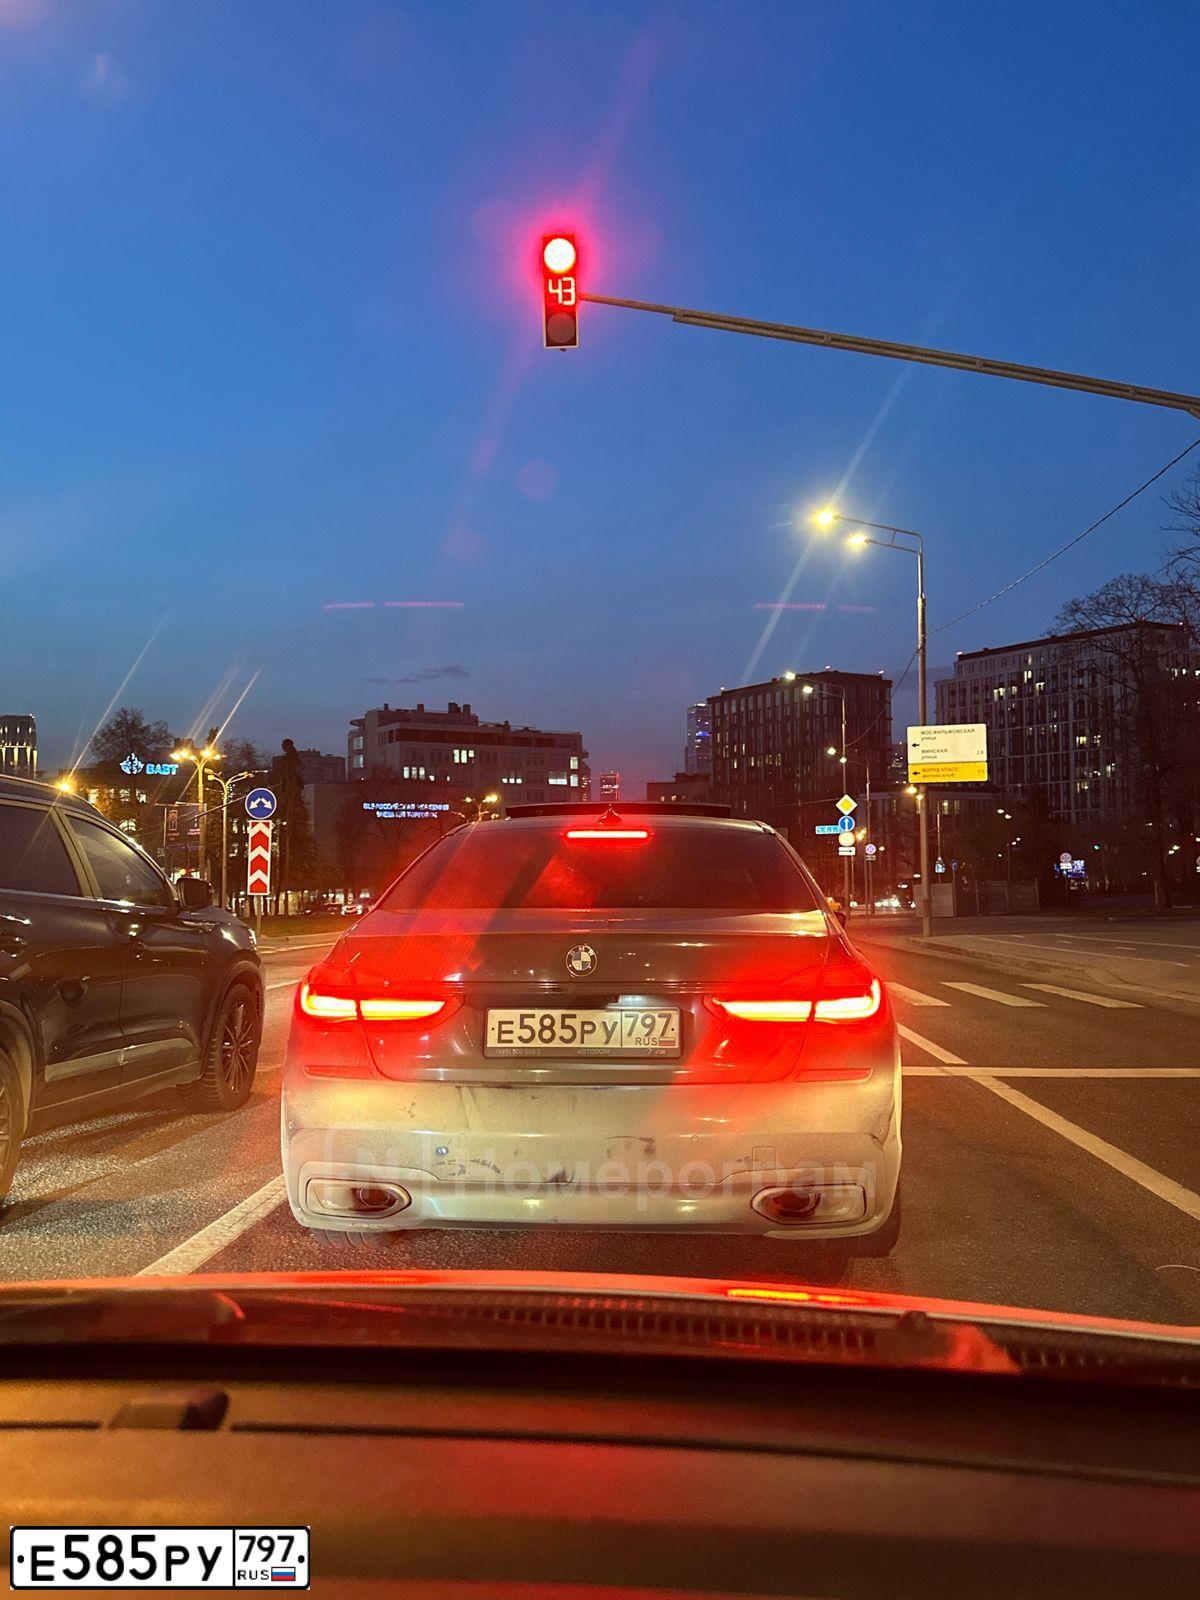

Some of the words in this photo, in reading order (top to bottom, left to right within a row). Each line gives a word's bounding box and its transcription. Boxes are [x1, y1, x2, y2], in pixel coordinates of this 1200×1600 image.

[548, 277, 575, 305] 43
[624, 1013, 672, 1037] 797
[635, 1036, 658, 1046] RUS
